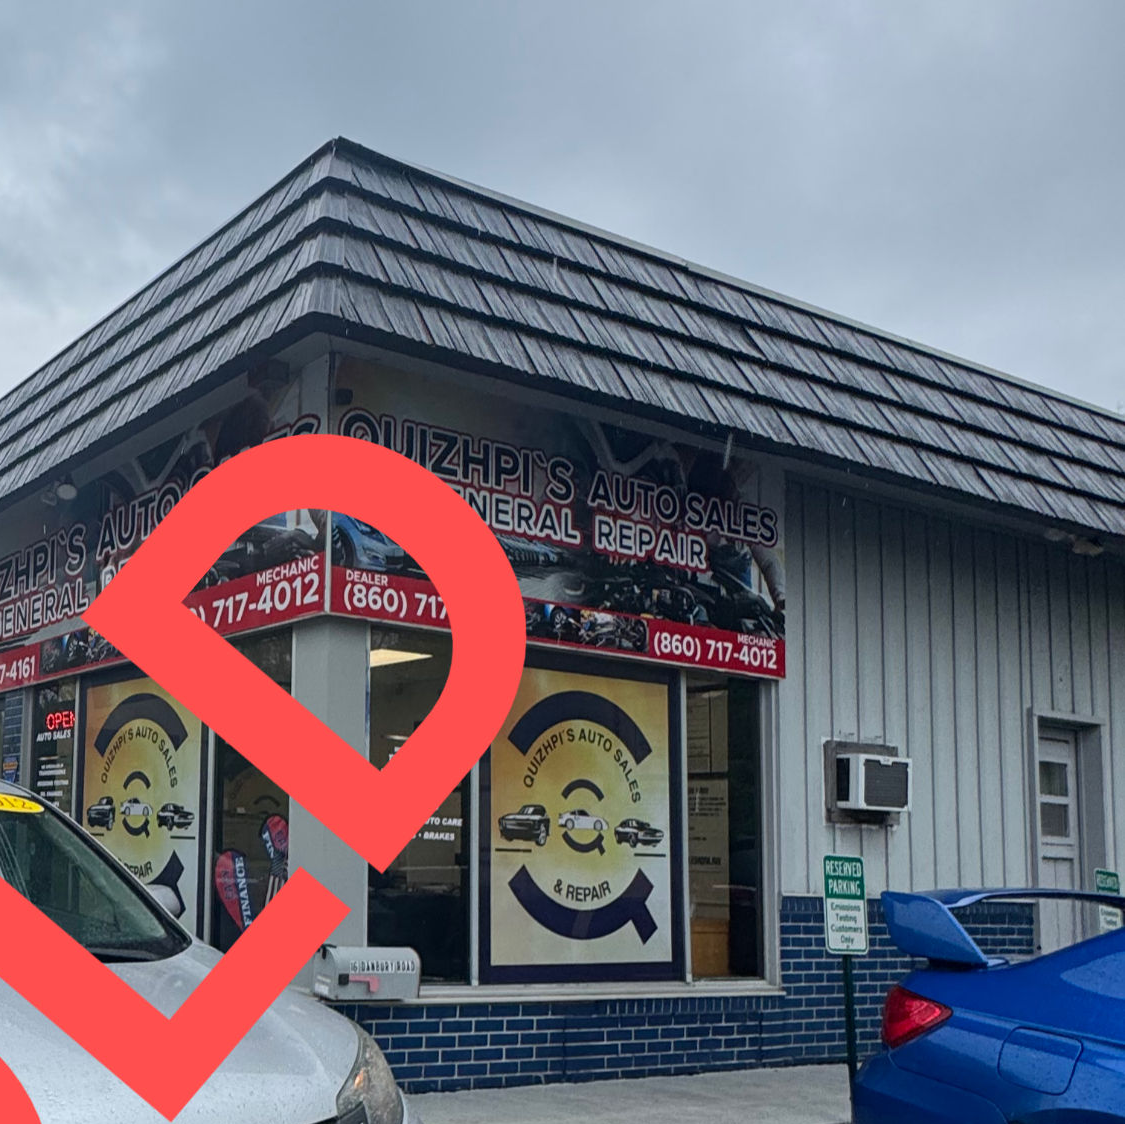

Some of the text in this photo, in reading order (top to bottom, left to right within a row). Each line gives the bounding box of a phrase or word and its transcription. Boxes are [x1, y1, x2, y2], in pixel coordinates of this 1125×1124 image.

[588, 470, 679, 523] AUTO
[686, 492, 778, 546] SALES
[595, 515, 707, 570] REPAIR
[256, 555, 320, 587] MECHANIC
[346, 569, 389, 587] DEALER
[212, 572, 320, 628] 717-4012
[343, 585, 408, 617] (860)
[653, 630, 778, 670] (860) 717-4012
[737, 633, 777, 649] MECHANIC
[135, 726, 159, 745] AUTO
[158, 739, 178, 788] SALES
[578, 728, 613, 753] AUTO
[613, 749, 642, 804] SALES
[423, 831, 455, 841] BRAKES
[825, 859, 862, 877] RESERVED
[235, 856, 253, 927] FINANCE
[565, 880, 612, 902] REPAIR
[828, 878, 861, 895] PARKING
[840, 935, 854, 945] Only
[396, 960, 416, 972] ROAD
